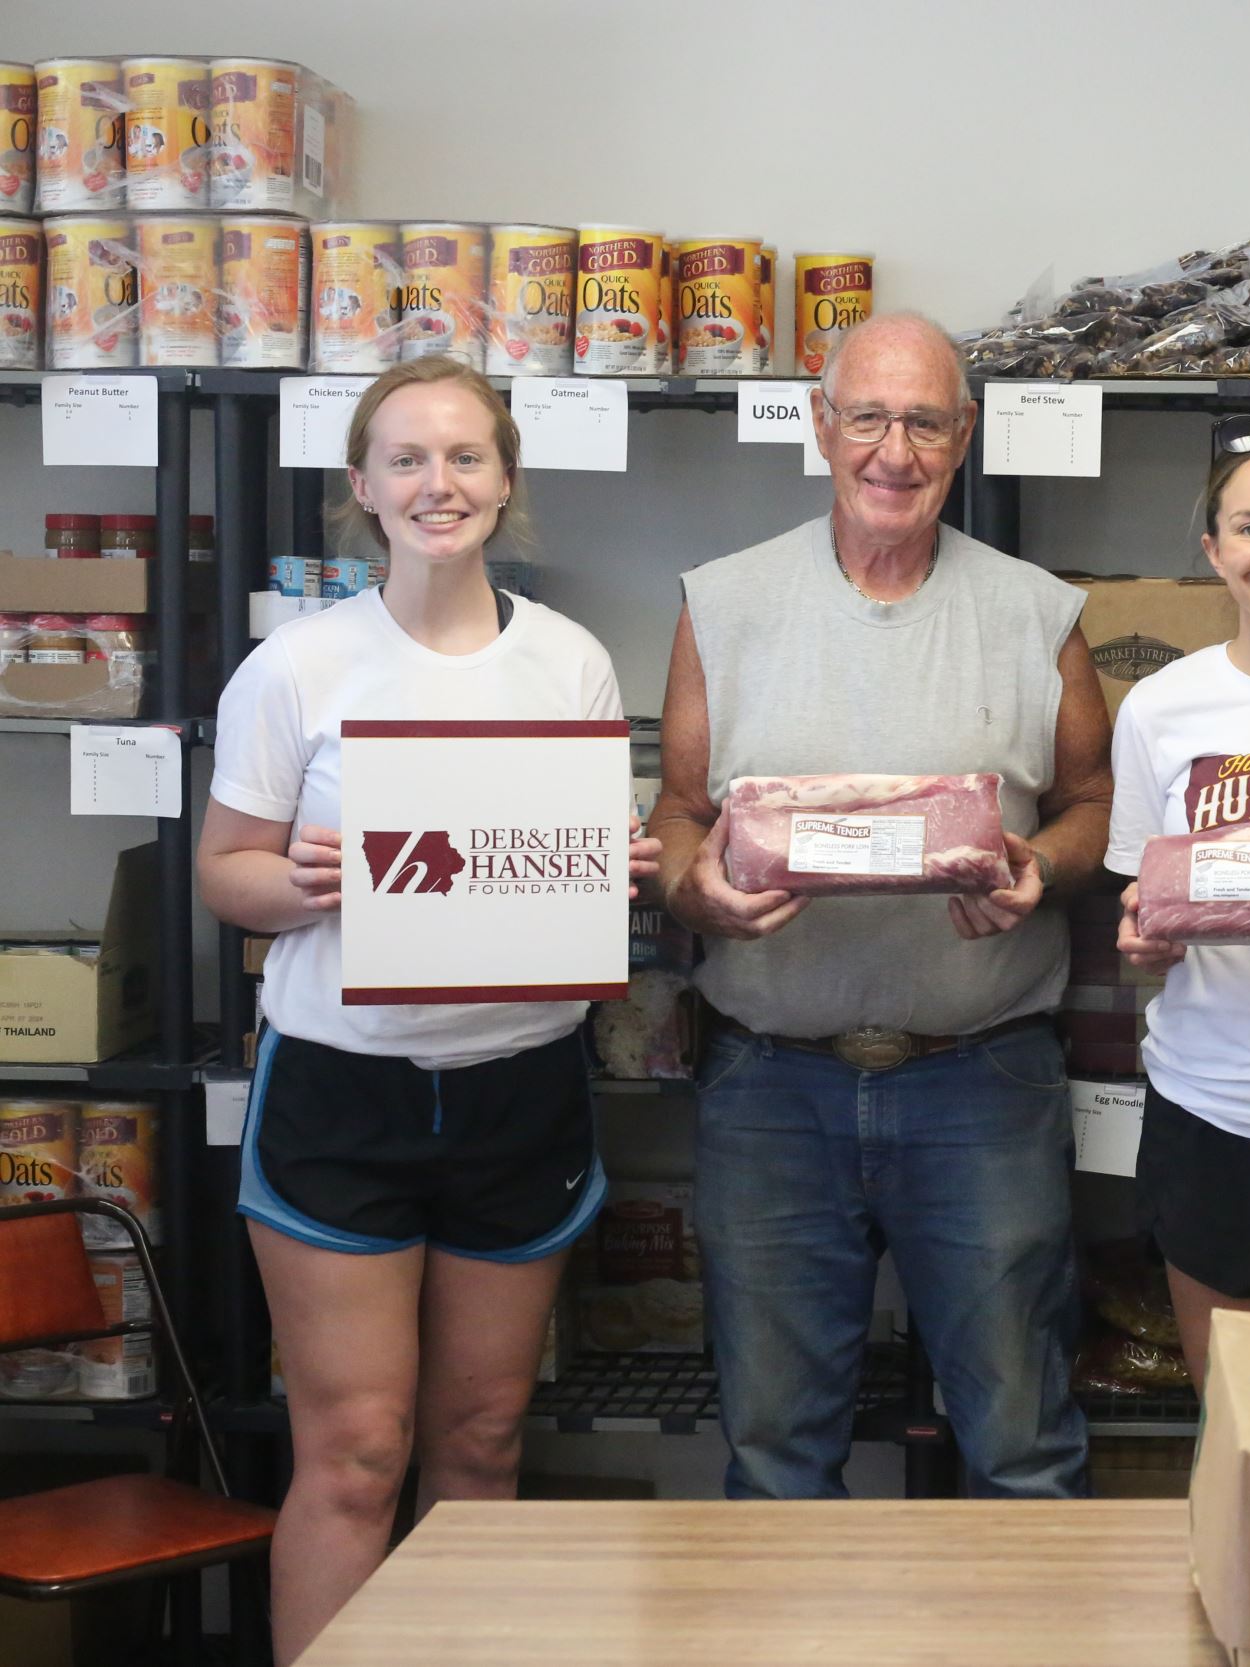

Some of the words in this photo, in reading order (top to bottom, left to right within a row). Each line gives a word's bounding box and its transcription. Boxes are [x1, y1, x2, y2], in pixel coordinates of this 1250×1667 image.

[588, 239, 636, 254] NORTHERN
[588, 250, 638, 271] GOLD
[682, 247, 727, 264] NORTHERN
[683, 256, 729, 277] GOLD
[819, 264, 864, 277] NORTHERN
[601, 274, 630, 284] QUICK
[693, 281, 721, 291] QUICK
[819, 273, 865, 292] GOLD
[0, 279, 31, 310] ats
[582, 277, 640, 315] Oats
[835, 295, 860, 304] QUICK
[680, 285, 732, 320] Oats
[68, 387, 100, 397] Peanut
[101, 387, 129, 397] Butter
[308, 388, 343, 398] Chicken
[551, 388, 589, 399] Oatmeal
[1020, 395, 1041, 404] Beef
[1042, 395, 1065, 405] Stew
[752, 404, 801, 421] USDA
[1094, 647, 1137, 663] MARKET
[1140, 647, 1176, 662] STREET
[115, 737, 137, 746] Tuna
[796, 821, 835, 833] SUPREME
[836, 825, 870, 838] TENDER
[1196, 849, 1234, 861] SUPREME
[468, 853, 610, 879] HANSEN
[468, 882, 611, 896] FOUNDATION
[4, 1027, 56, 1037] THAILAND
[1094, 1094, 1110, 1105] Egg
[1112, 1096, 1144, 1109] Noodle
[0, 1152, 52, 1187] Oats
